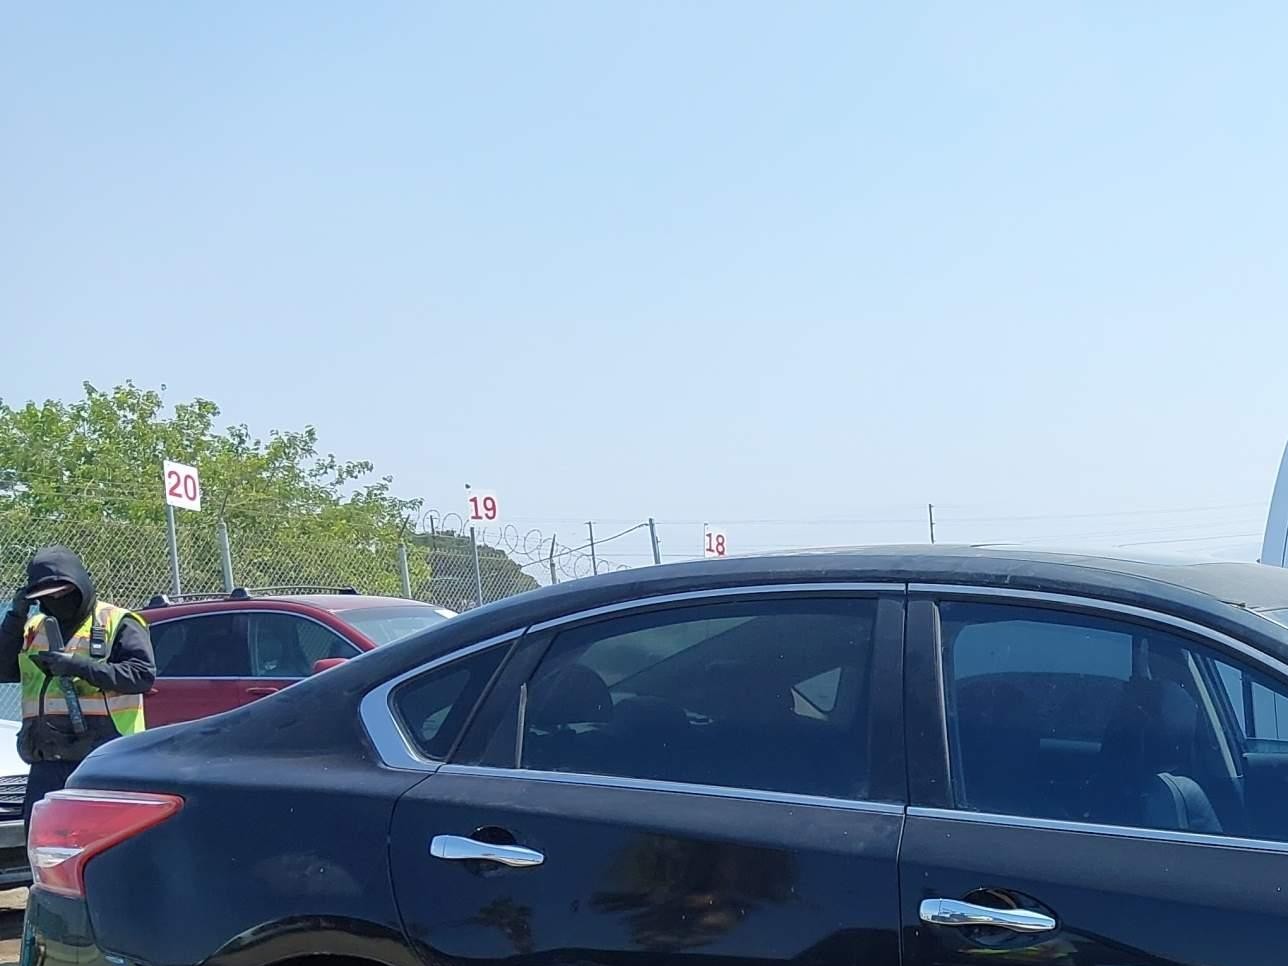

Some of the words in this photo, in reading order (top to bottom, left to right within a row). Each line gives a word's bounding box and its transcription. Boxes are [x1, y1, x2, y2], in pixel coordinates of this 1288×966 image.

[167, 470, 198, 502] 20
[469, 496, 497, 520] 19
[705, 532, 726, 556] 18
